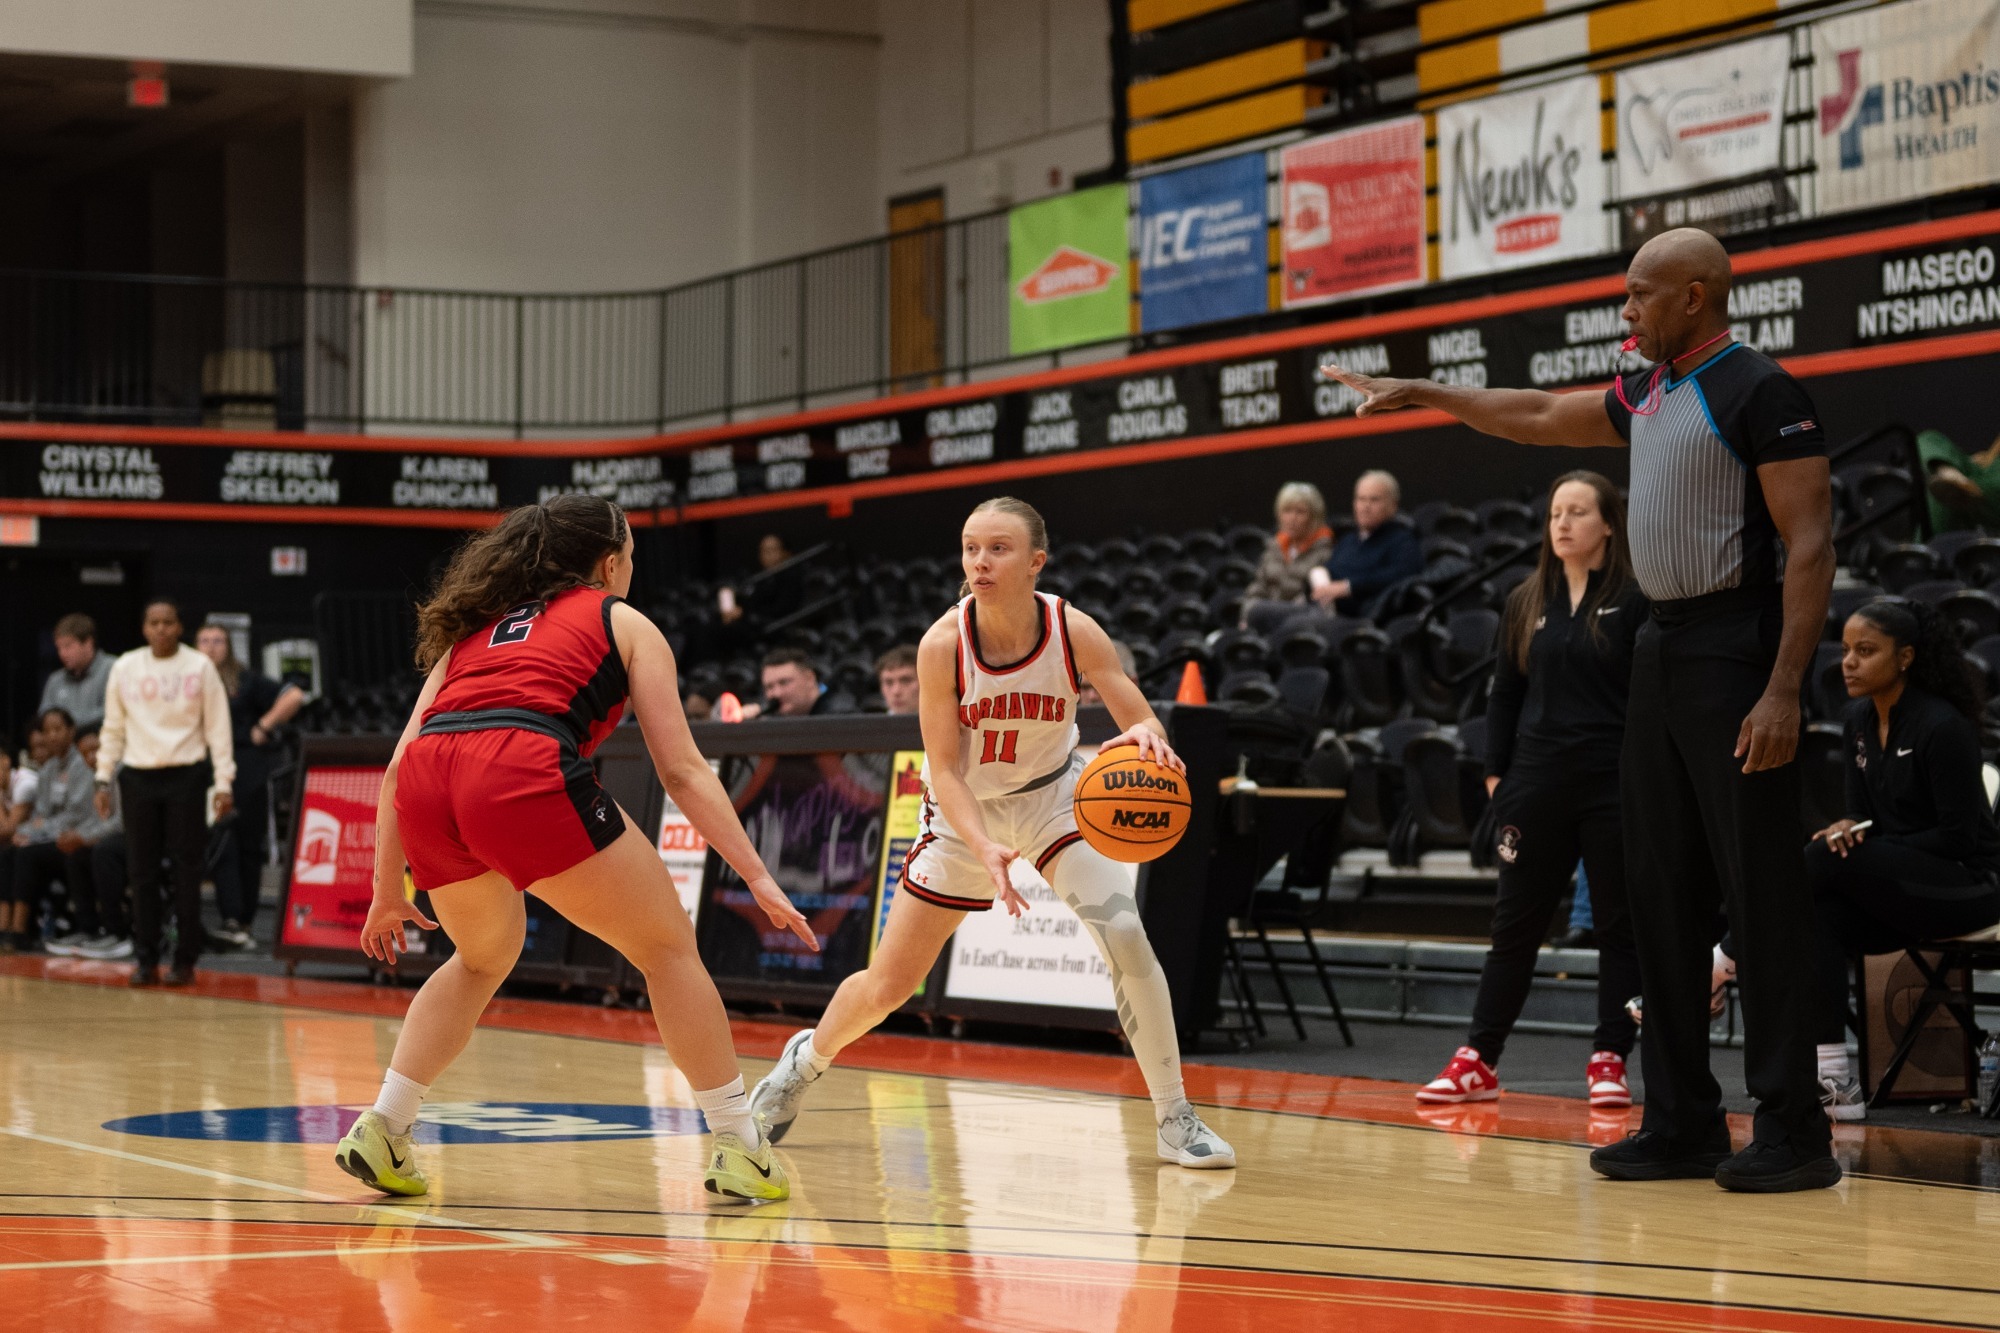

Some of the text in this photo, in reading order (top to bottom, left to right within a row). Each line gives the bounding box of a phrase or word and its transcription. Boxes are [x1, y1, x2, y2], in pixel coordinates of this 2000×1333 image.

[1450, 97, 1580, 244] Newk's
[1883, 246, 1995, 295] MASEGO
[1428, 328, 1487, 365] NIGEL
[1118, 376, 1177, 409] CARLA
[1219, 360, 1278, 396] BRETT
[1030, 391, 1073, 422] JACK
[1220, 393, 1280, 427] TEACH
[1108, 405, 1187, 442] DOUGLAS
[43, 444, 160, 474] CRYSTAL
[225, 450, 333, 477] JEFFREY
[402, 456, 489, 482] KAREN
[39, 471, 164, 500] WILLIAMS
[220, 476, 340, 503] SKELDON
[392, 481, 498, 507] DUNCAN
[487, 600, 547, 648] 2
[980, 729, 1019, 765] 11
[1102, 769, 1179, 795] Wilson
[1111, 809, 1170, 829] NCAA
[960, 949, 970, 966] In
[1026, 956, 1058, 972] across
[1060, 955, 1086, 974] from
